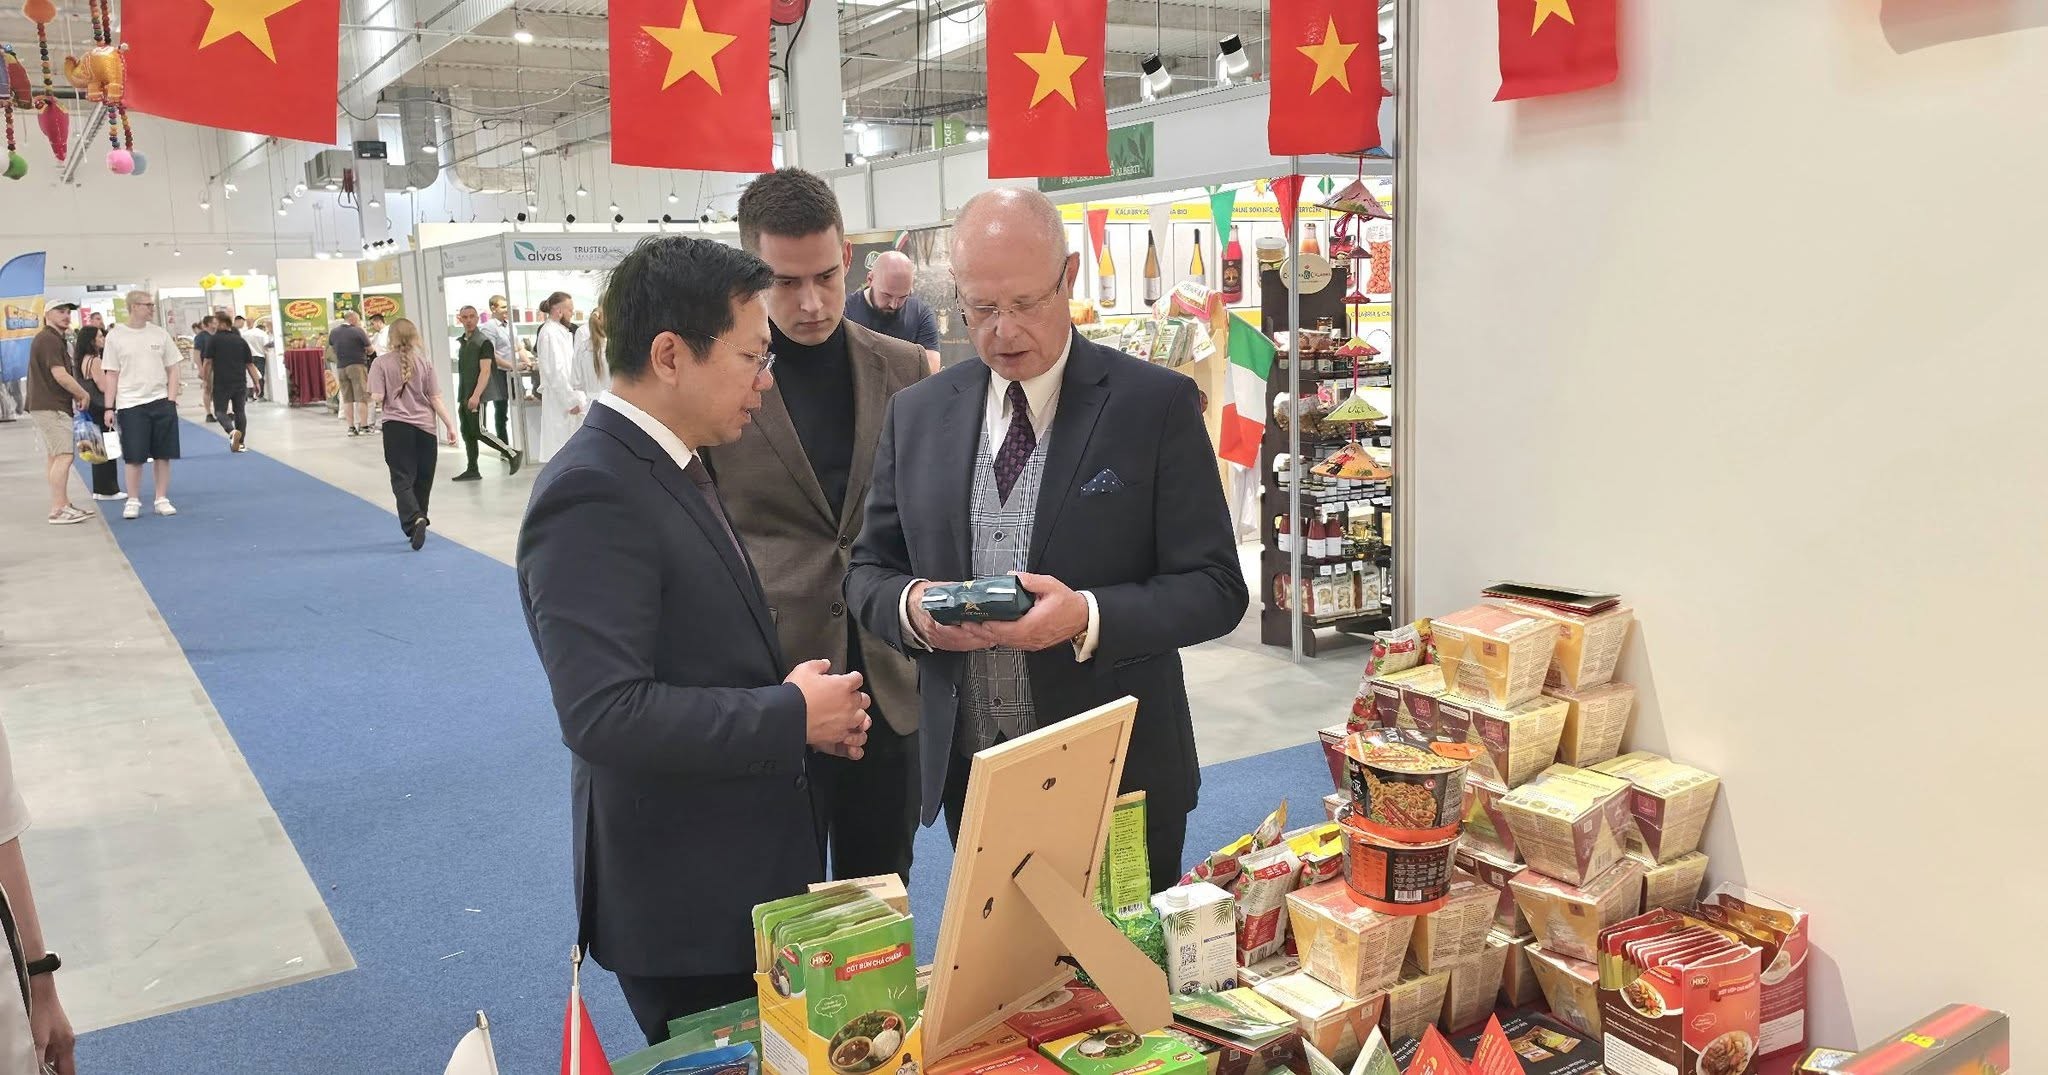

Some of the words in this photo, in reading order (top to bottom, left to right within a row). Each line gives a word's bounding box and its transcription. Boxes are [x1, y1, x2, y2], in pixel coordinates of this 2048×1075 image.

[944, 122, 952, 144] DGE
[528, 251, 562, 261] alvas
[812, 953, 831, 965] HXC
[1692, 977, 1707, 985] HXC
